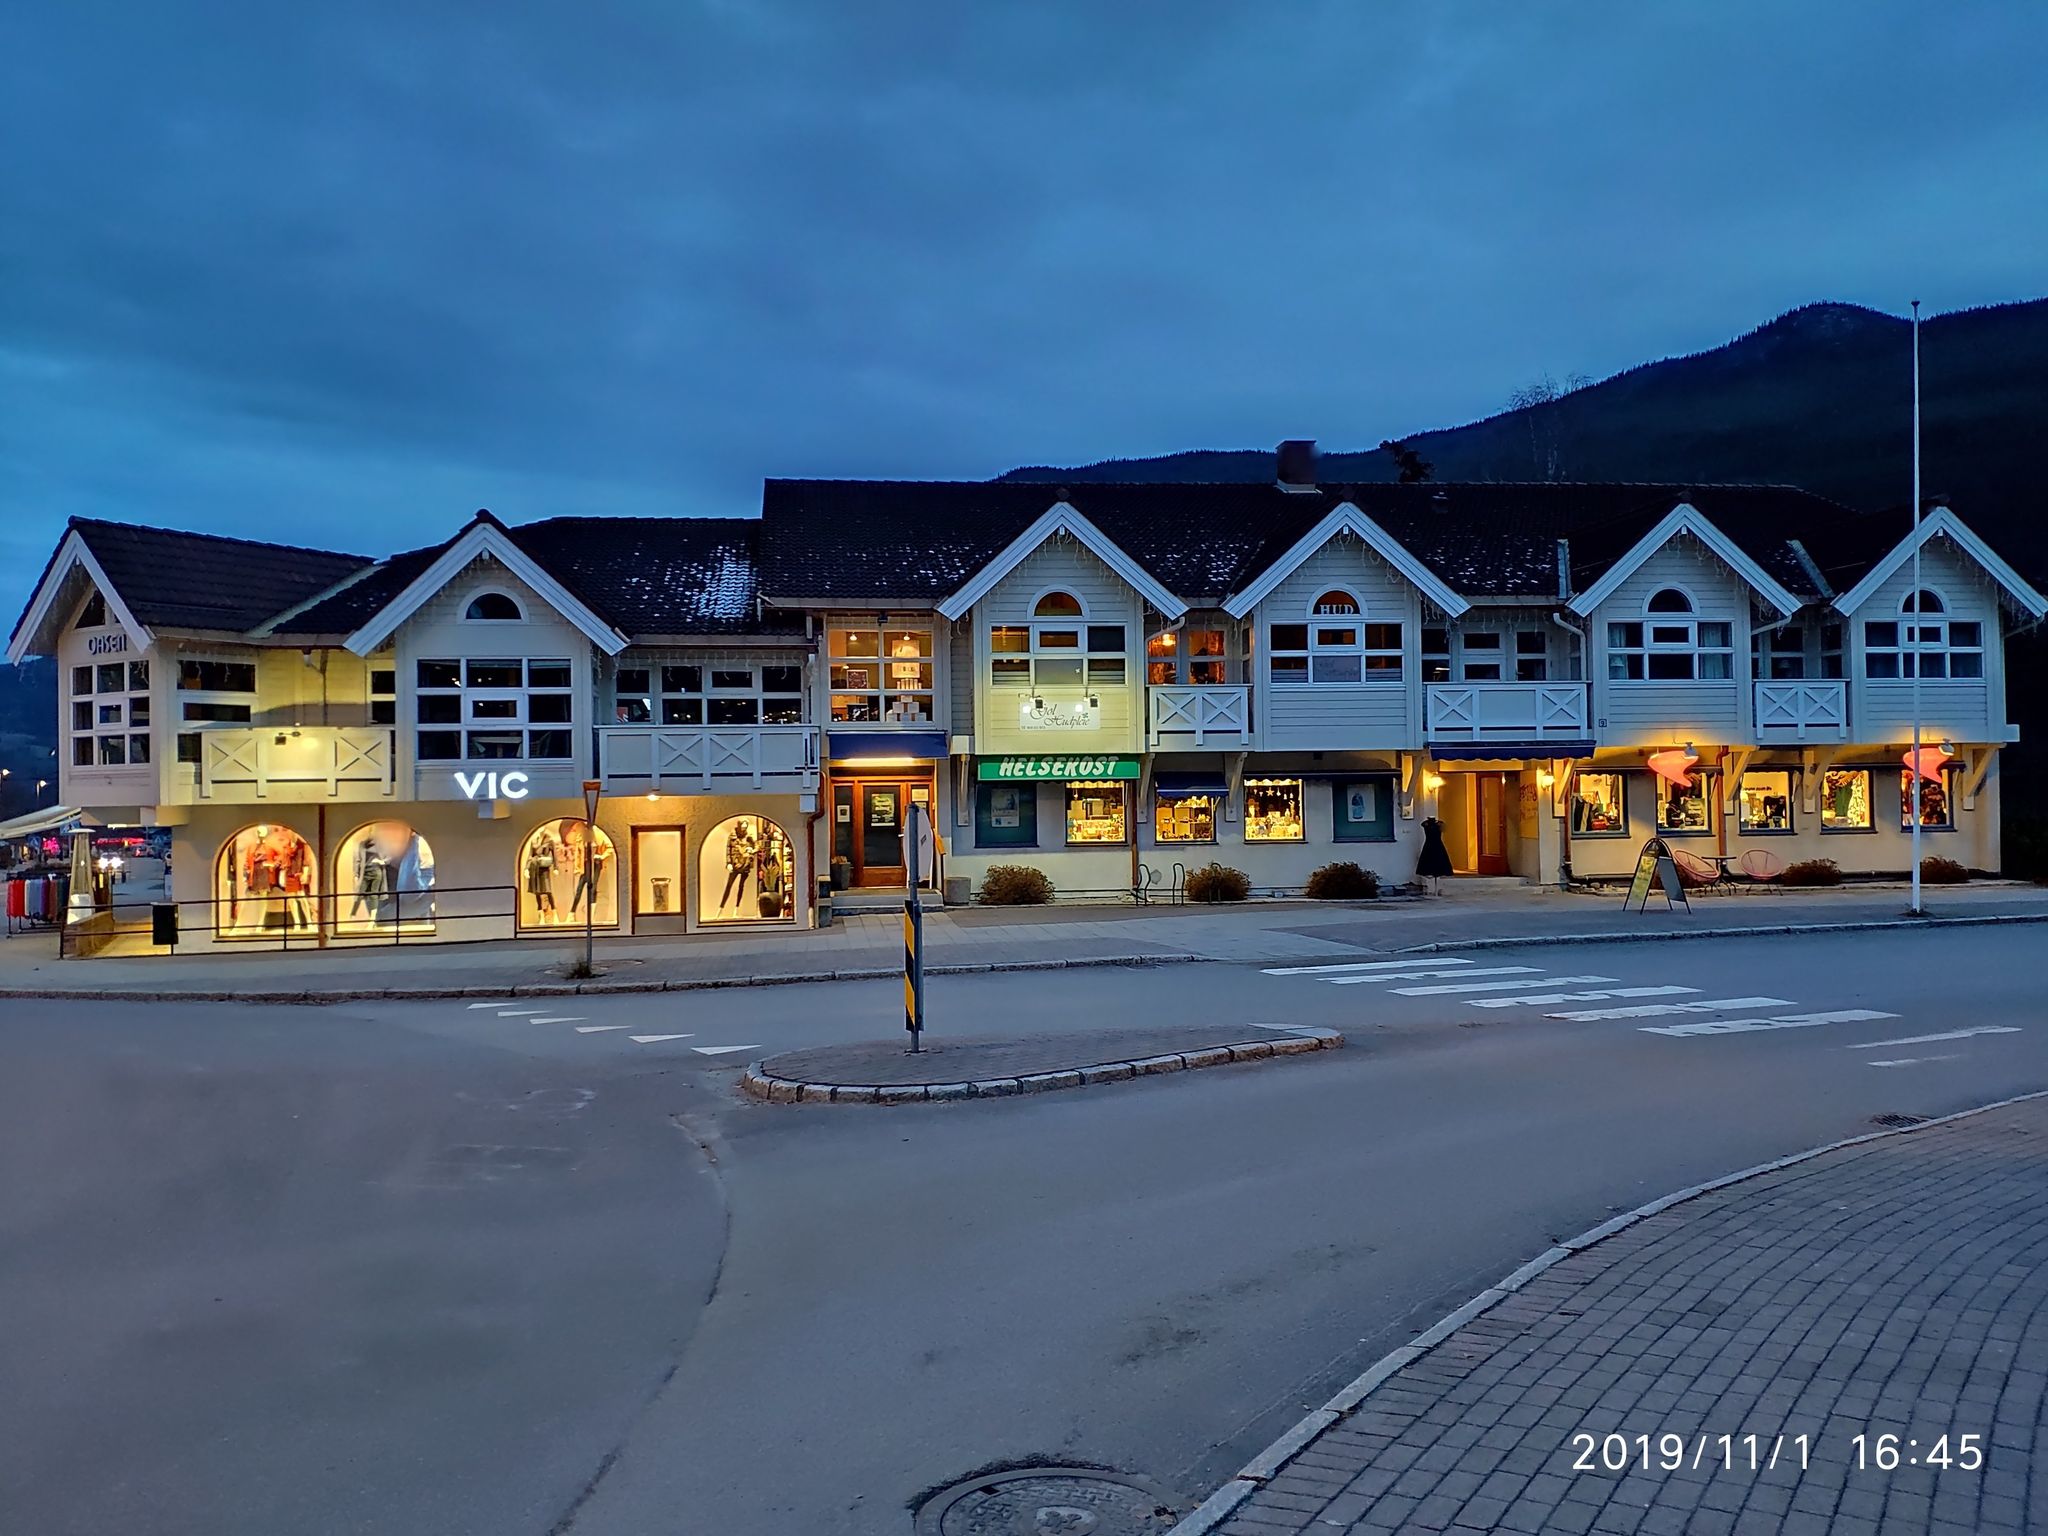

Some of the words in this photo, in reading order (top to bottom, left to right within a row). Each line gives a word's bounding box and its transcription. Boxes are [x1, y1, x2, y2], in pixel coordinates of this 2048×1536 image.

[1320, 604, 1354, 615] HUD
[999, 756, 1119, 777] HELSEKOST
[454, 772, 529, 799] VIC
